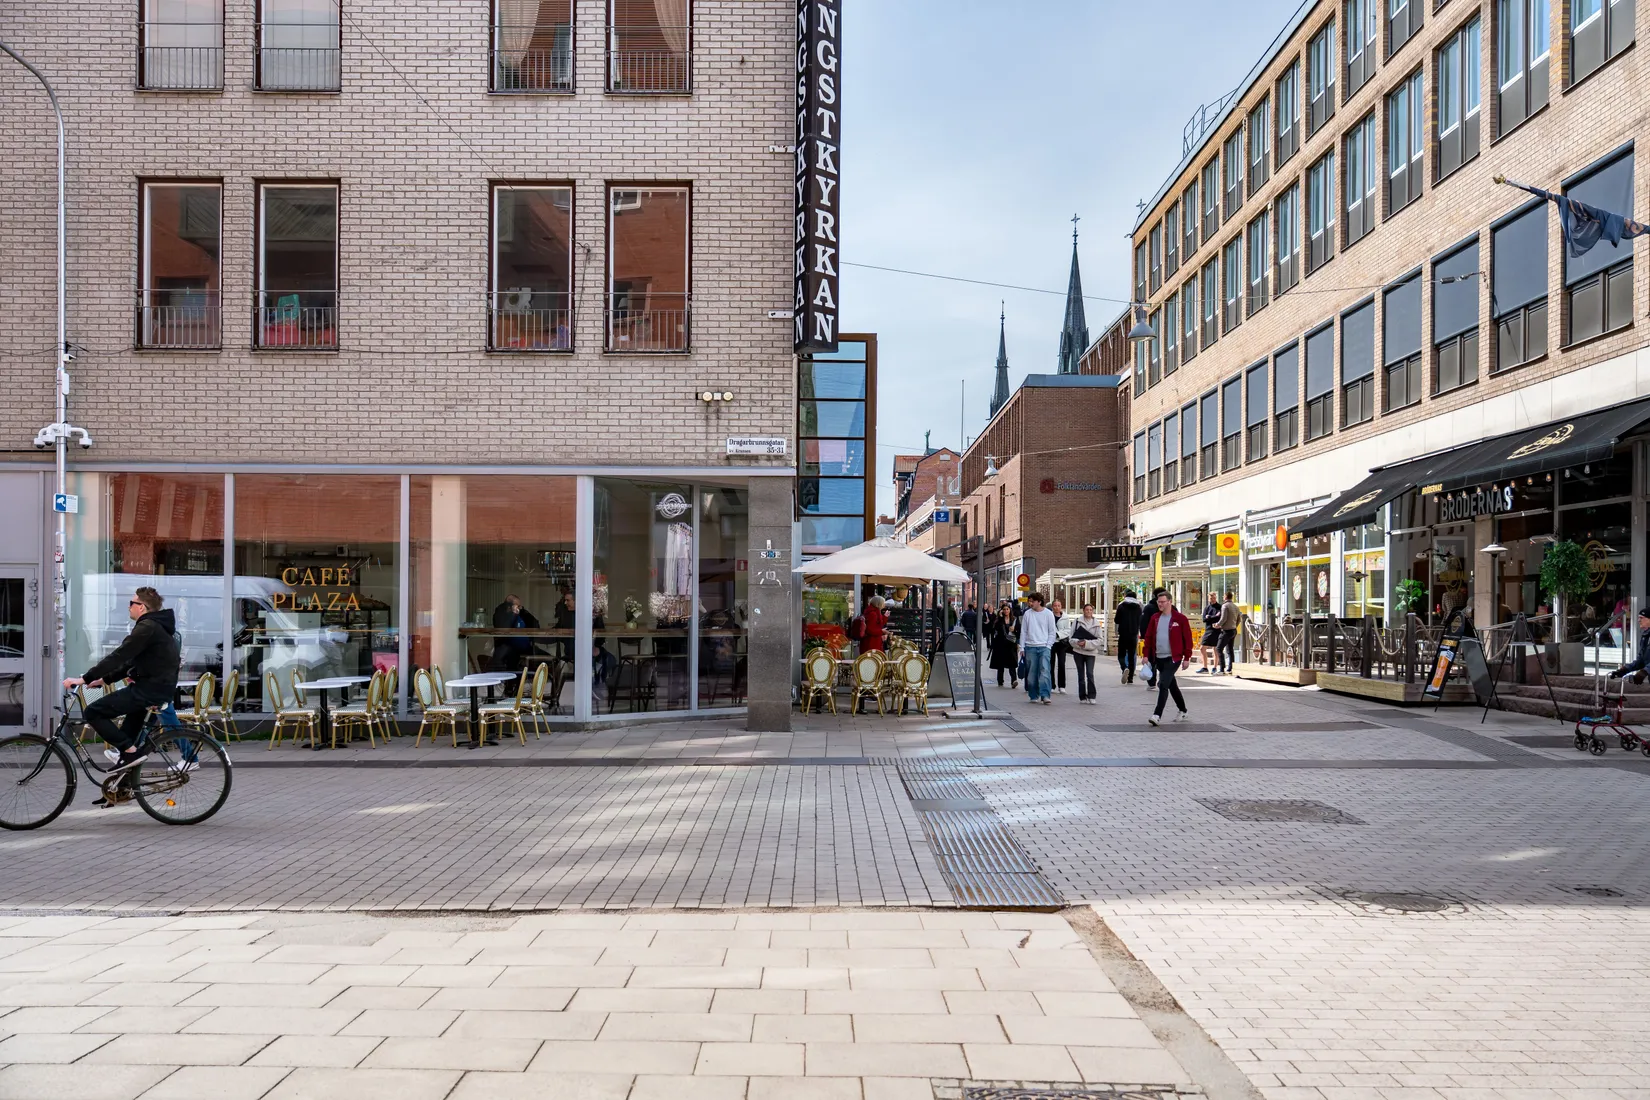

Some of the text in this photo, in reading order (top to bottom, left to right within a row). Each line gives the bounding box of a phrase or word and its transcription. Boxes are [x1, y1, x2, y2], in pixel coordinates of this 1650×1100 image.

[795, 0, 808, 344] NGSTKYRKAN
[814, 0, 838, 343] NGSTKYRKAN
[729, 439, 784, 447] Dragarbrunnsgatan
[1441, 486, 1512, 521] BRÖDERNAS
[1100, 546, 1137, 558] TAVERNA
[282, 563, 351, 587] CAFÉ
[273, 592, 361, 611] PLAZA
